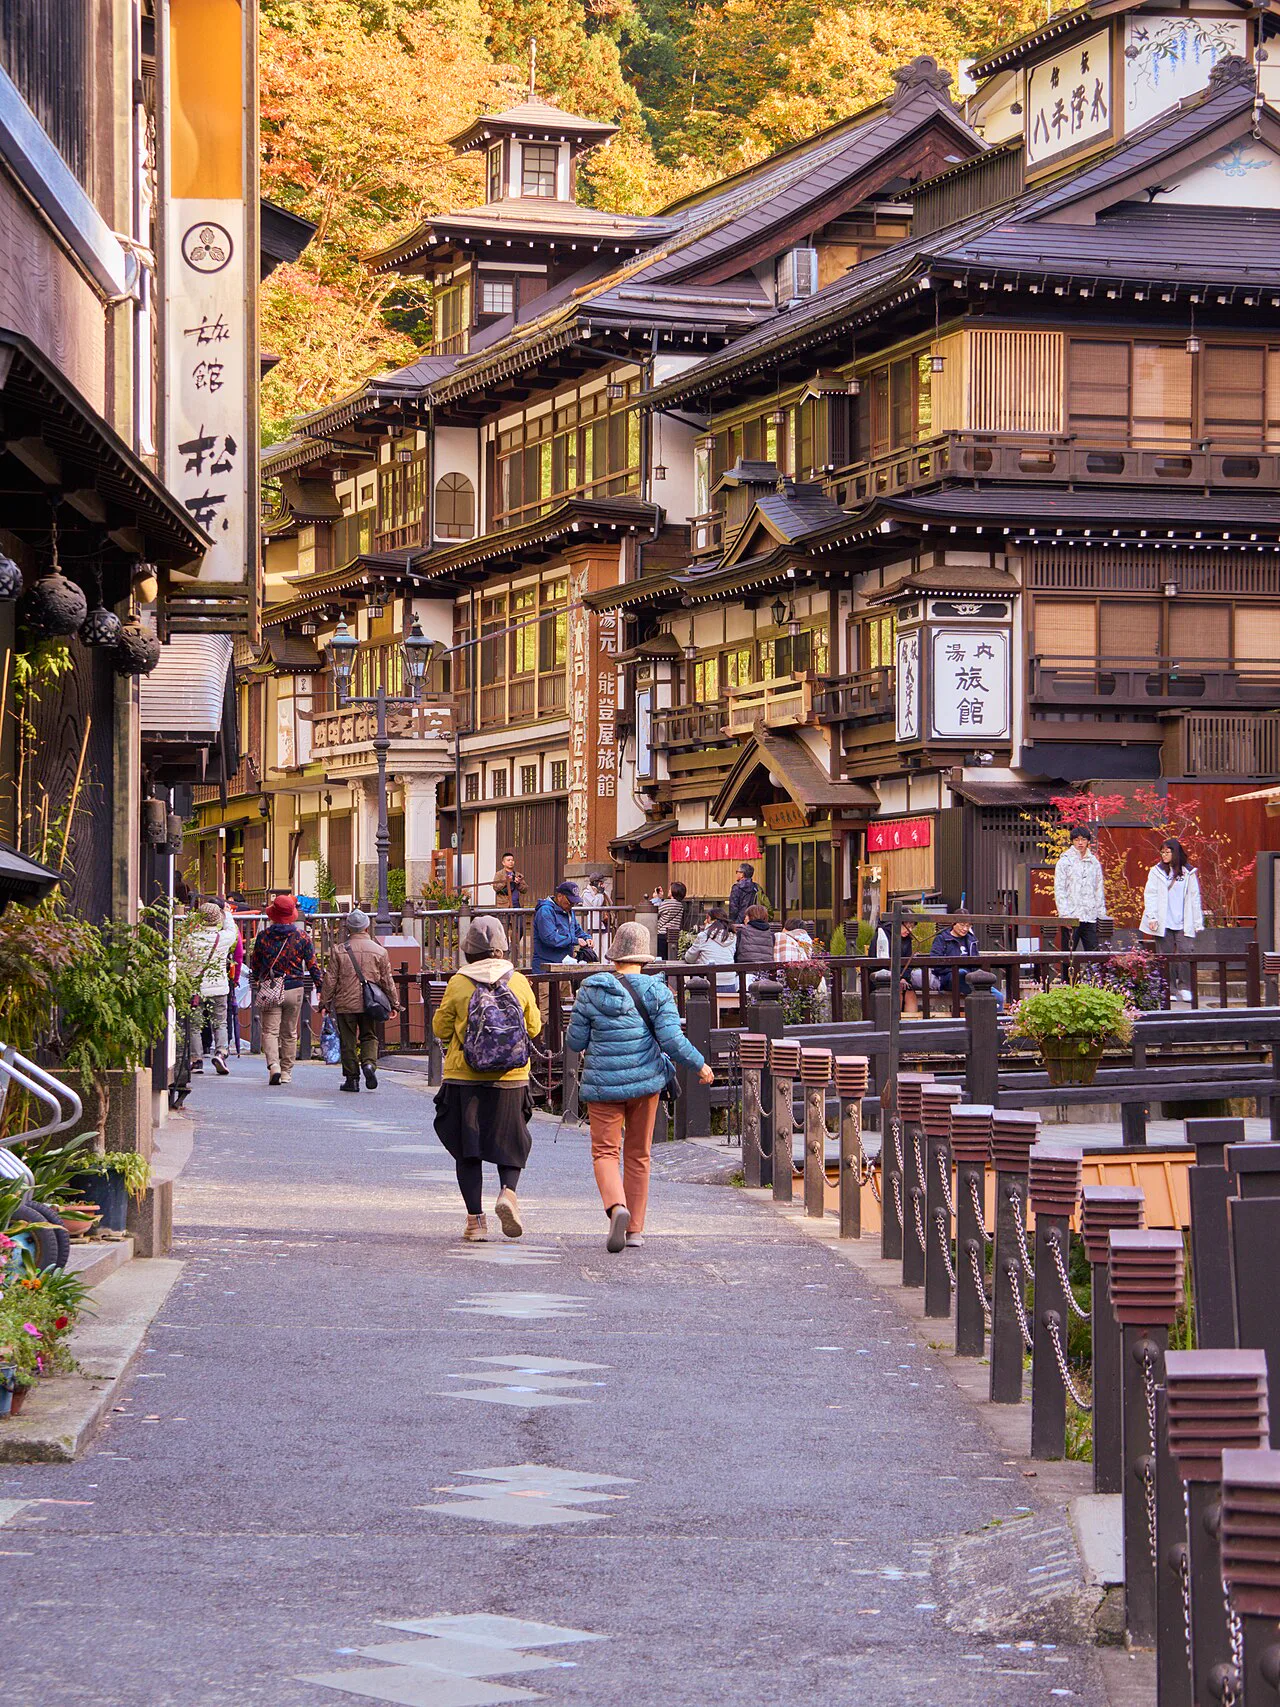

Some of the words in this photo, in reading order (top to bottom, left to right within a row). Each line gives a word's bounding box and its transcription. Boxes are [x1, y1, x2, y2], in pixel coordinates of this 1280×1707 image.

[597, 671, 615, 797] 能登屋旅館
[955, 666, 989, 725] 旅館
